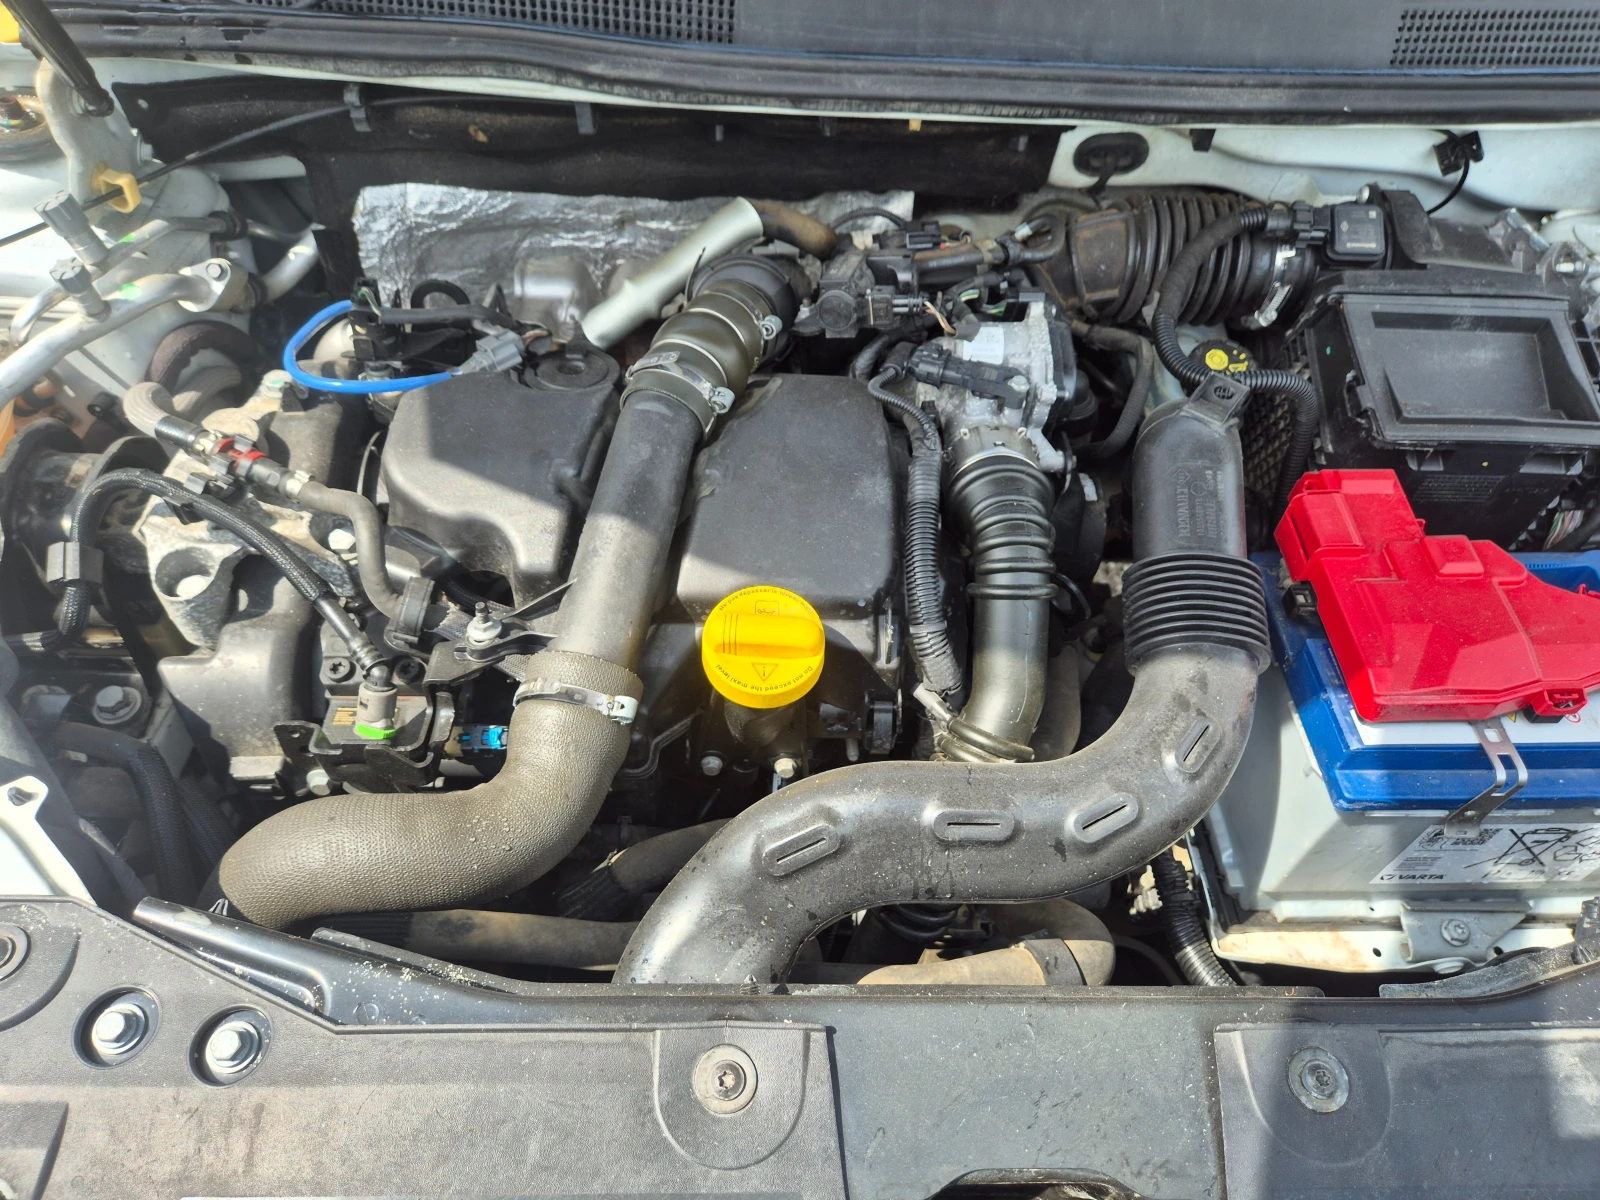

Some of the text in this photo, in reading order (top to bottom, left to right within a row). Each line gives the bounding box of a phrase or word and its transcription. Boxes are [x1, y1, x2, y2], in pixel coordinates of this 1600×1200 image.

[1176, 486, 1190, 538] RENAULT
[728, 595, 738, 604] pas
[715, 664, 730, 679] level
[804, 665, 813, 675] Do
[730, 677, 748, 688] maxi
[793, 673, 804, 683] not
[764, 682, 791, 691] exceed
